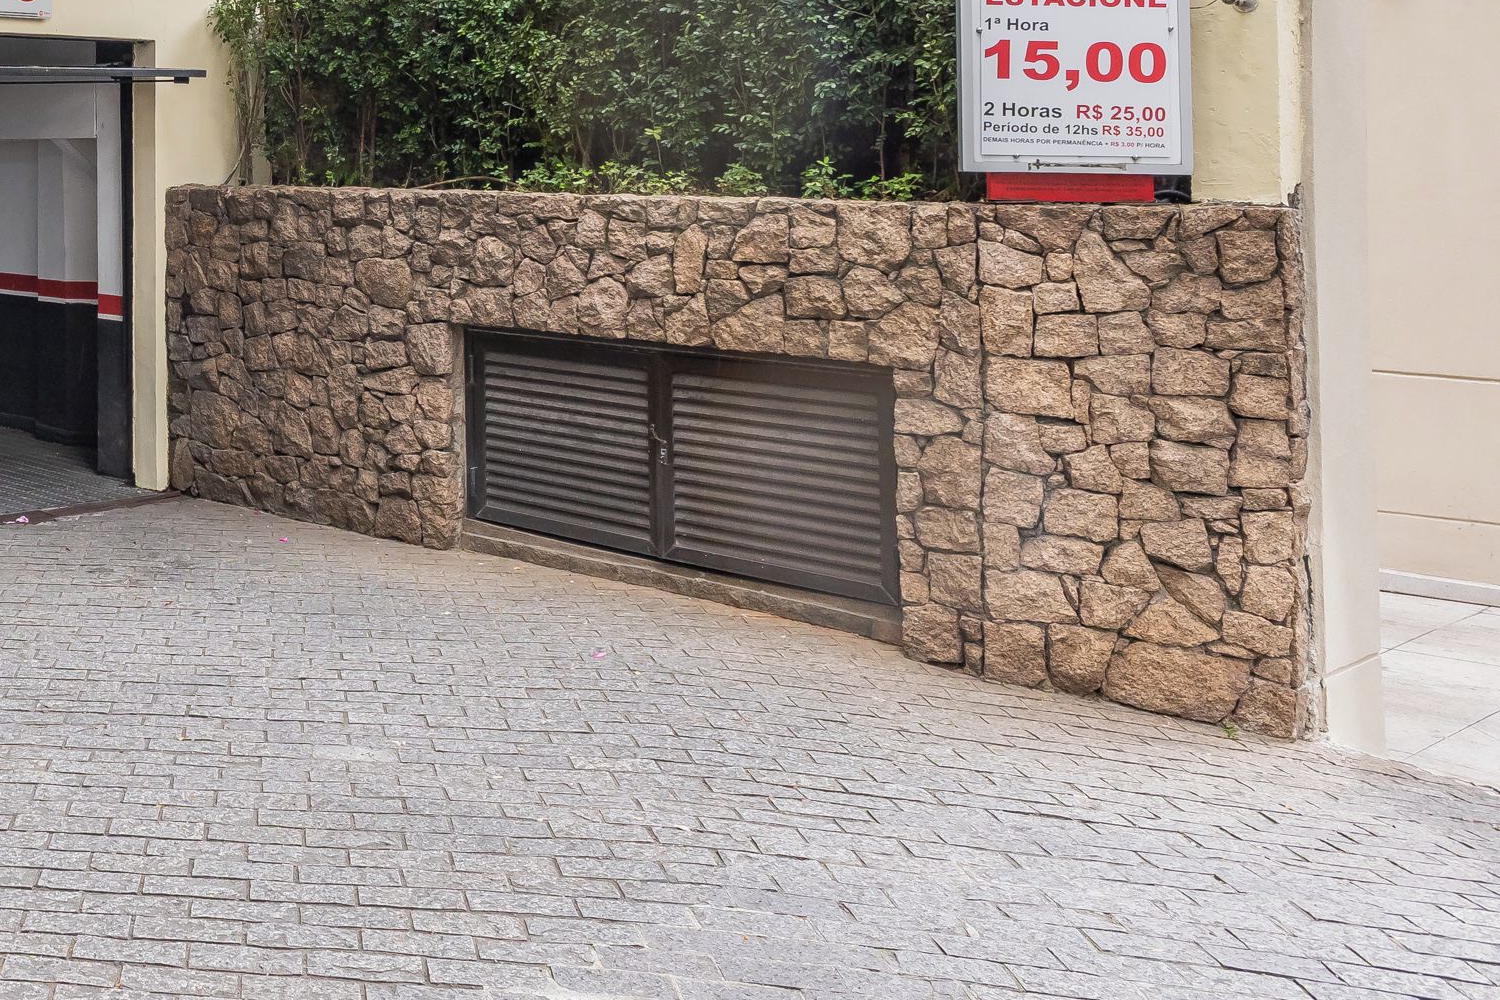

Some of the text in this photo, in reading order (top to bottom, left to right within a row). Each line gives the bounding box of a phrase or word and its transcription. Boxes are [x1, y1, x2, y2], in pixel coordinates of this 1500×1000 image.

[1007, 18, 1049, 31] Hora
[984, 39, 1167, 92] 15,00
[984, 101, 1166, 124] 2 Horas R$ 25,00
[983, 121, 1164, 138] Período de 12hs R$ 35,00
[1052, 139, 1103, 147] PERMANÊNCIA
